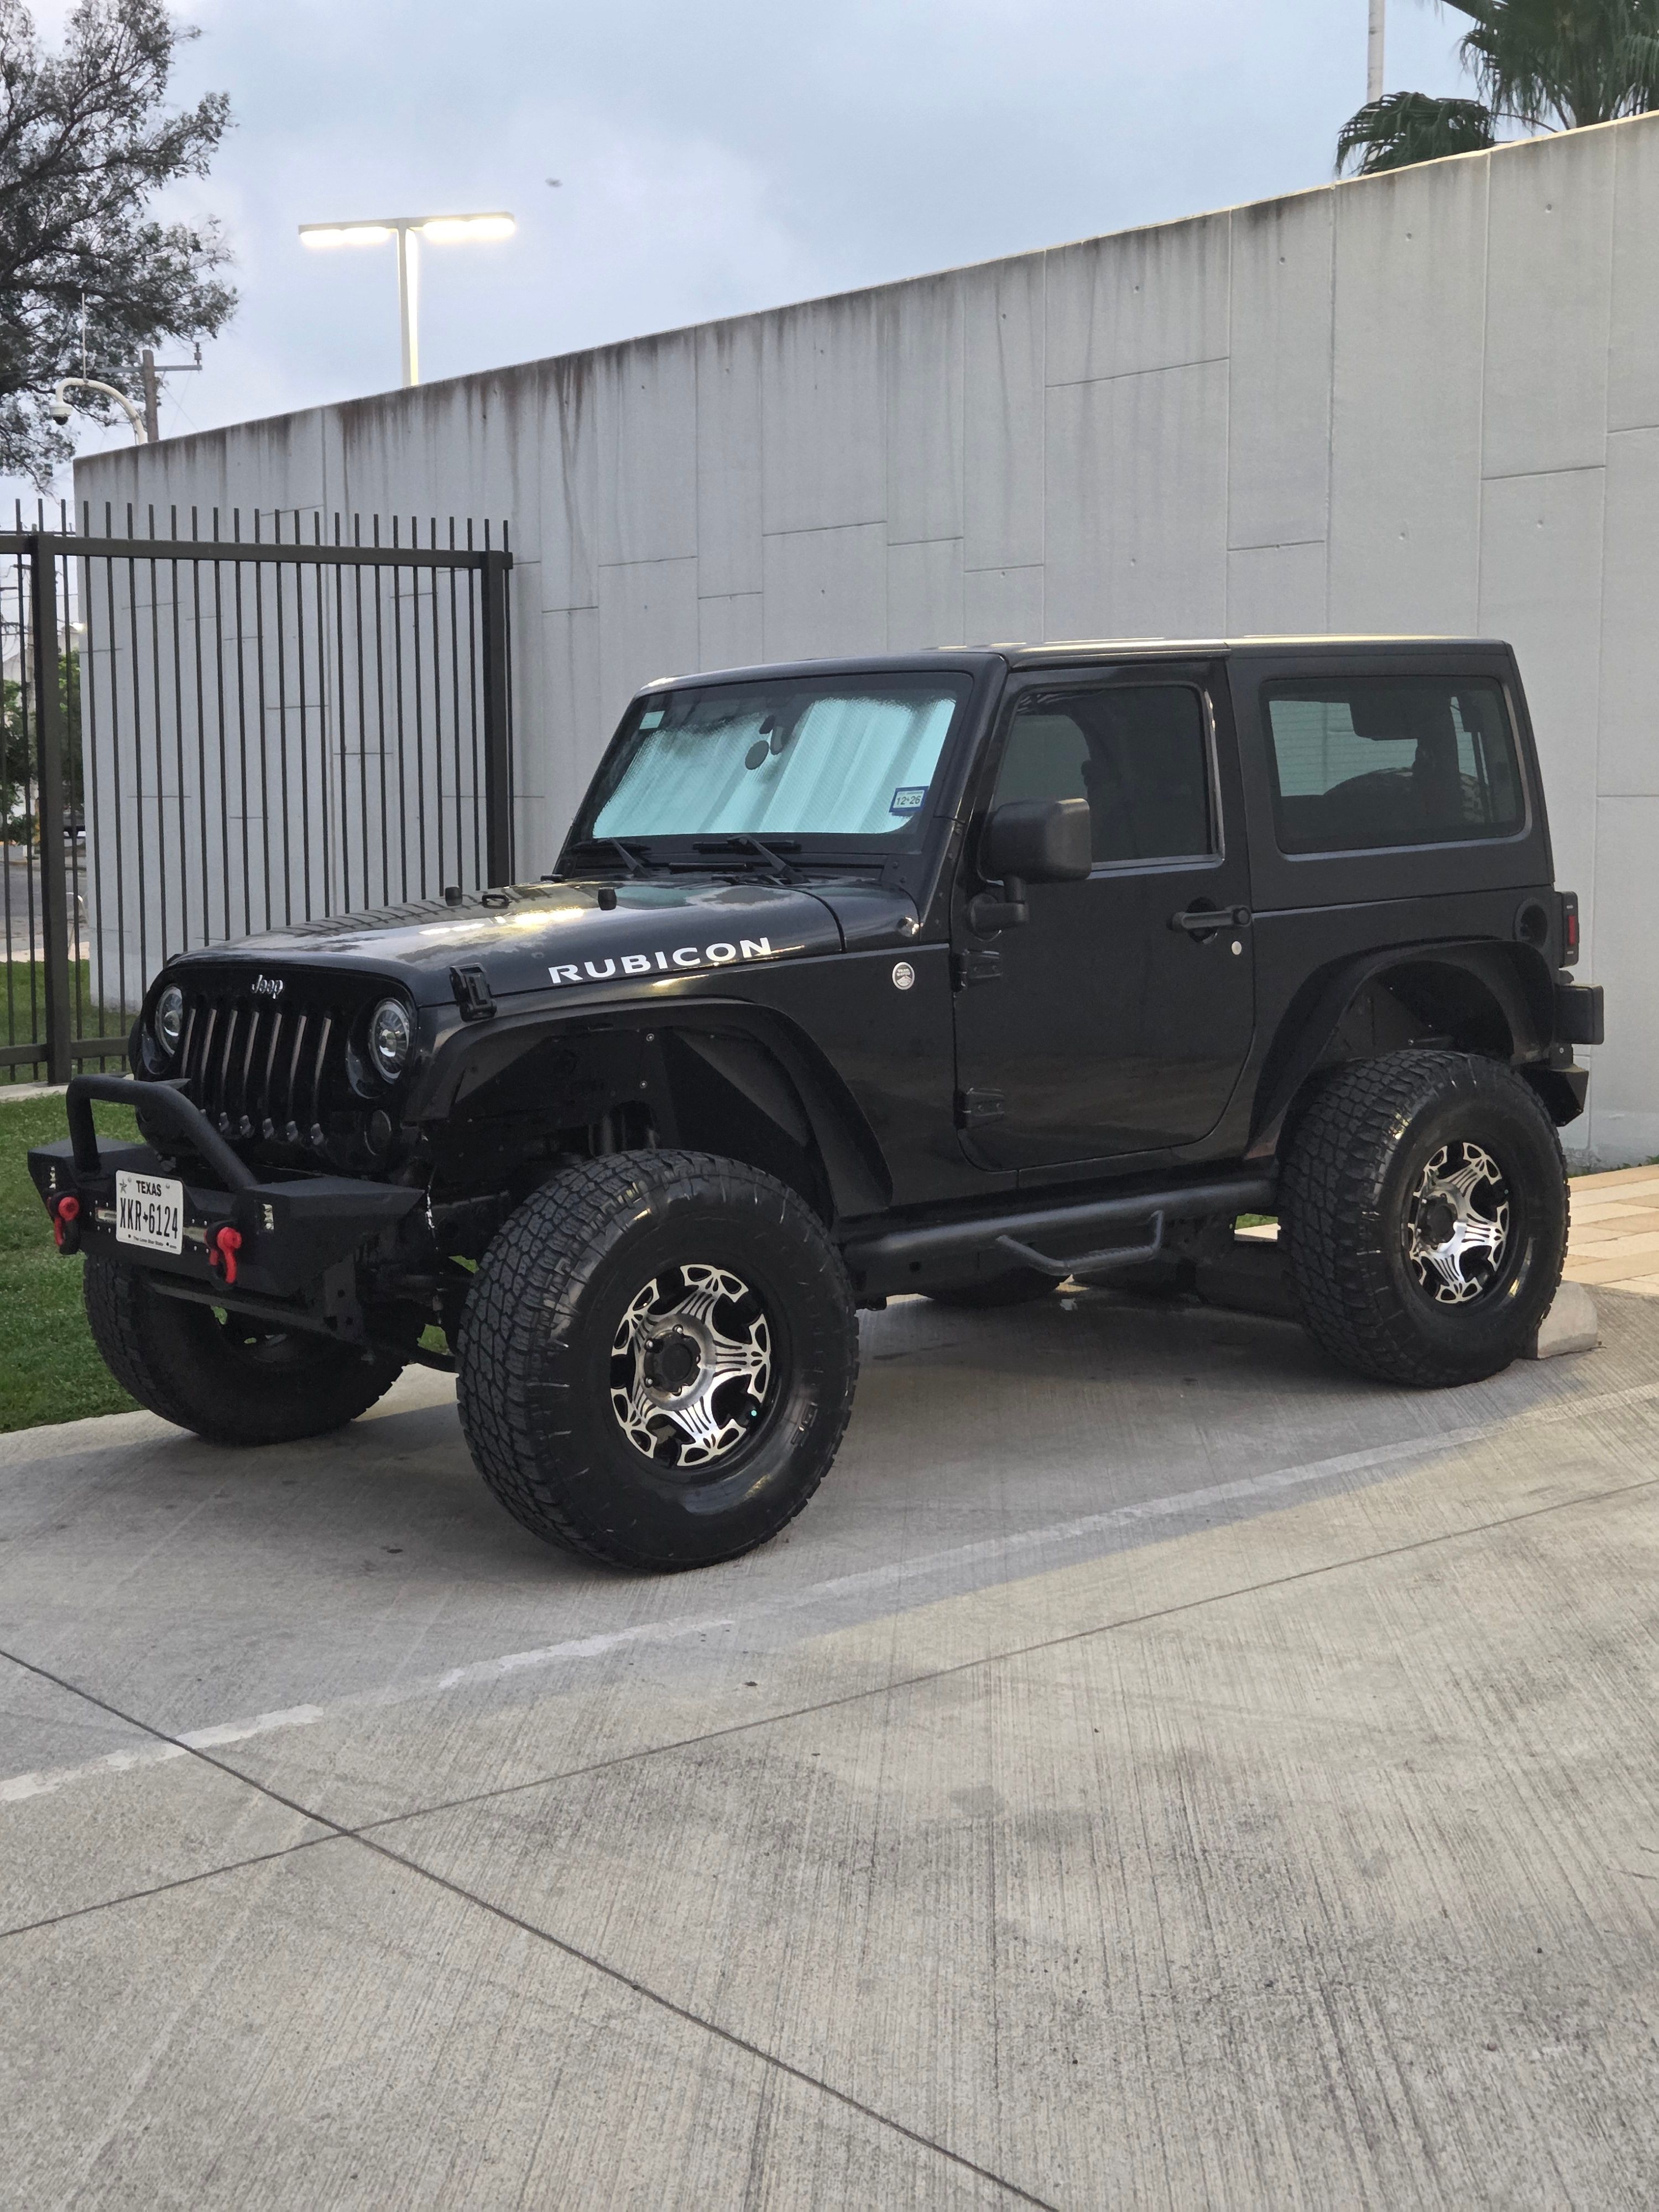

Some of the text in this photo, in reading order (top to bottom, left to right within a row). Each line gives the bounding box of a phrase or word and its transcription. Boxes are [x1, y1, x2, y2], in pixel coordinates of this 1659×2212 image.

[547, 937, 771, 984] RUBICON
[251, 974, 283, 999] Jeep
[136, 1180, 161, 1197] TEXAS
